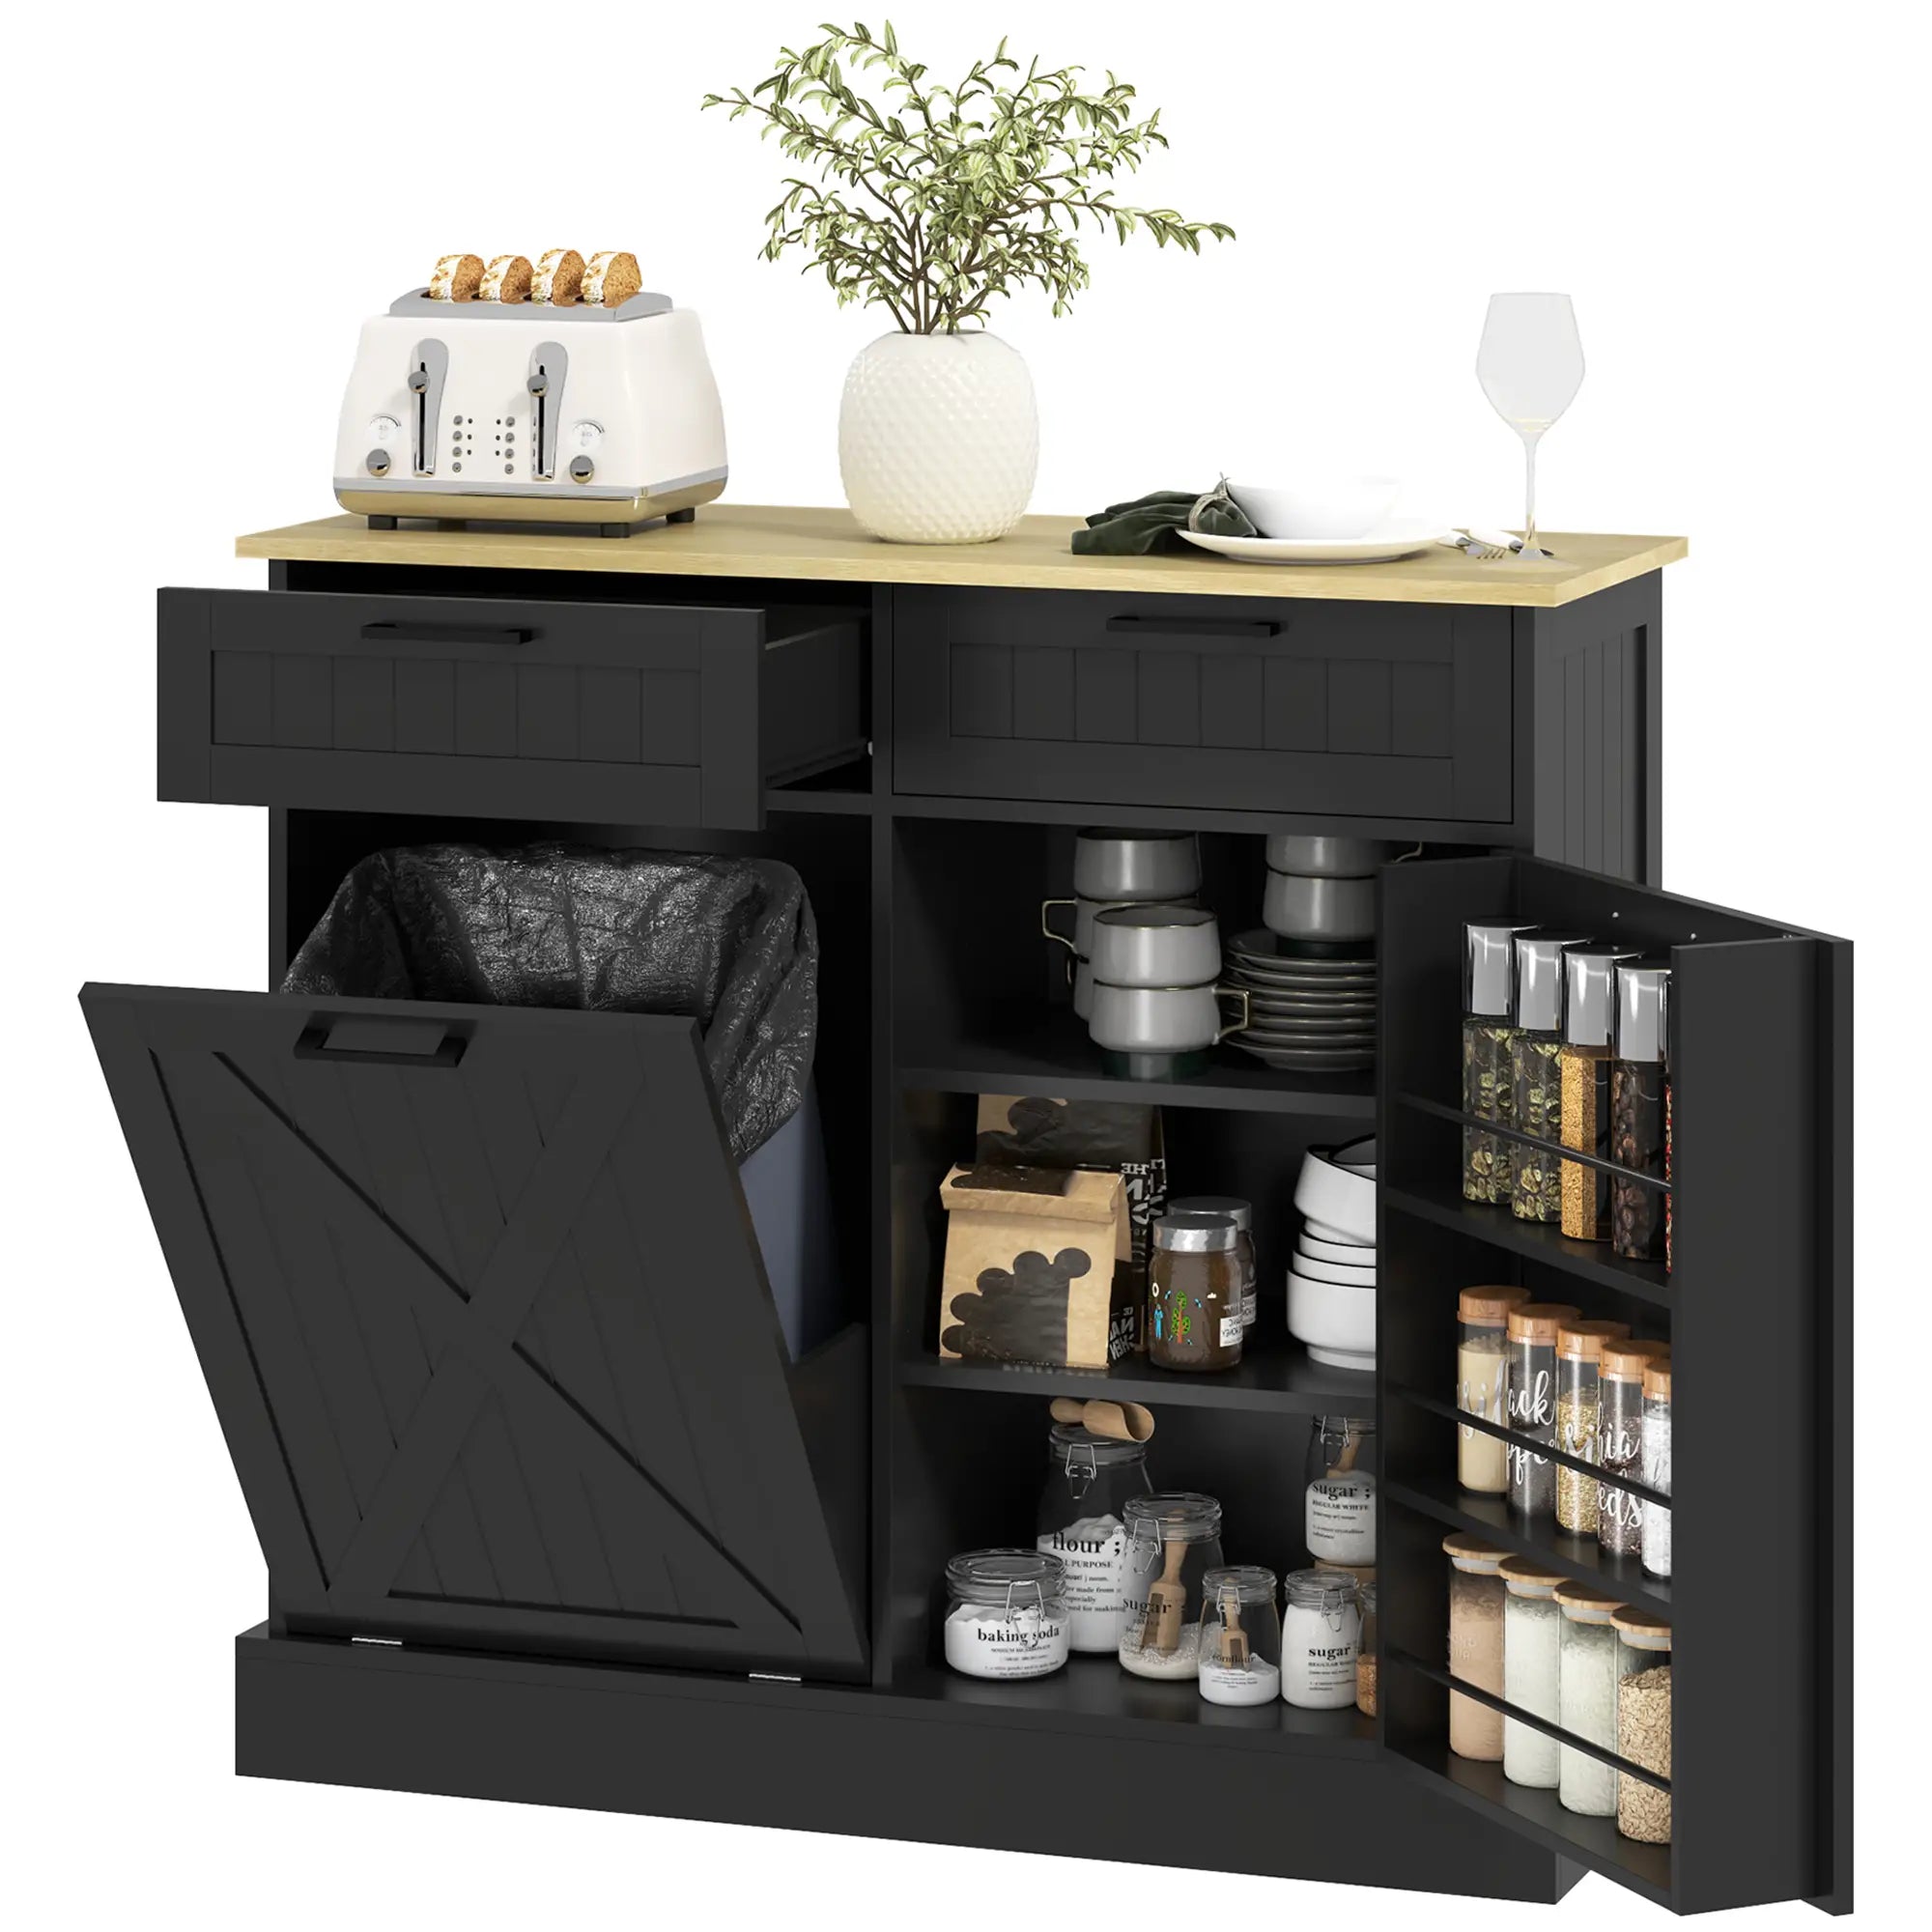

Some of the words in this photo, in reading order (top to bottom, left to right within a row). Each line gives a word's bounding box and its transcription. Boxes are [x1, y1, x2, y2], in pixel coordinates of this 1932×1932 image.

[1312, 1482, 1358, 1500] sugar
[1053, 1531, 1105, 1553] flour
[1071, 1560, 1114, 1569] PURPOSE
[1122, 1598, 1172, 1617] sugar
[978, 1628, 1029, 1647] baking
[1032, 1625, 1060, 1641] soda
[1308, 1646, 1350, 1661] sugar
